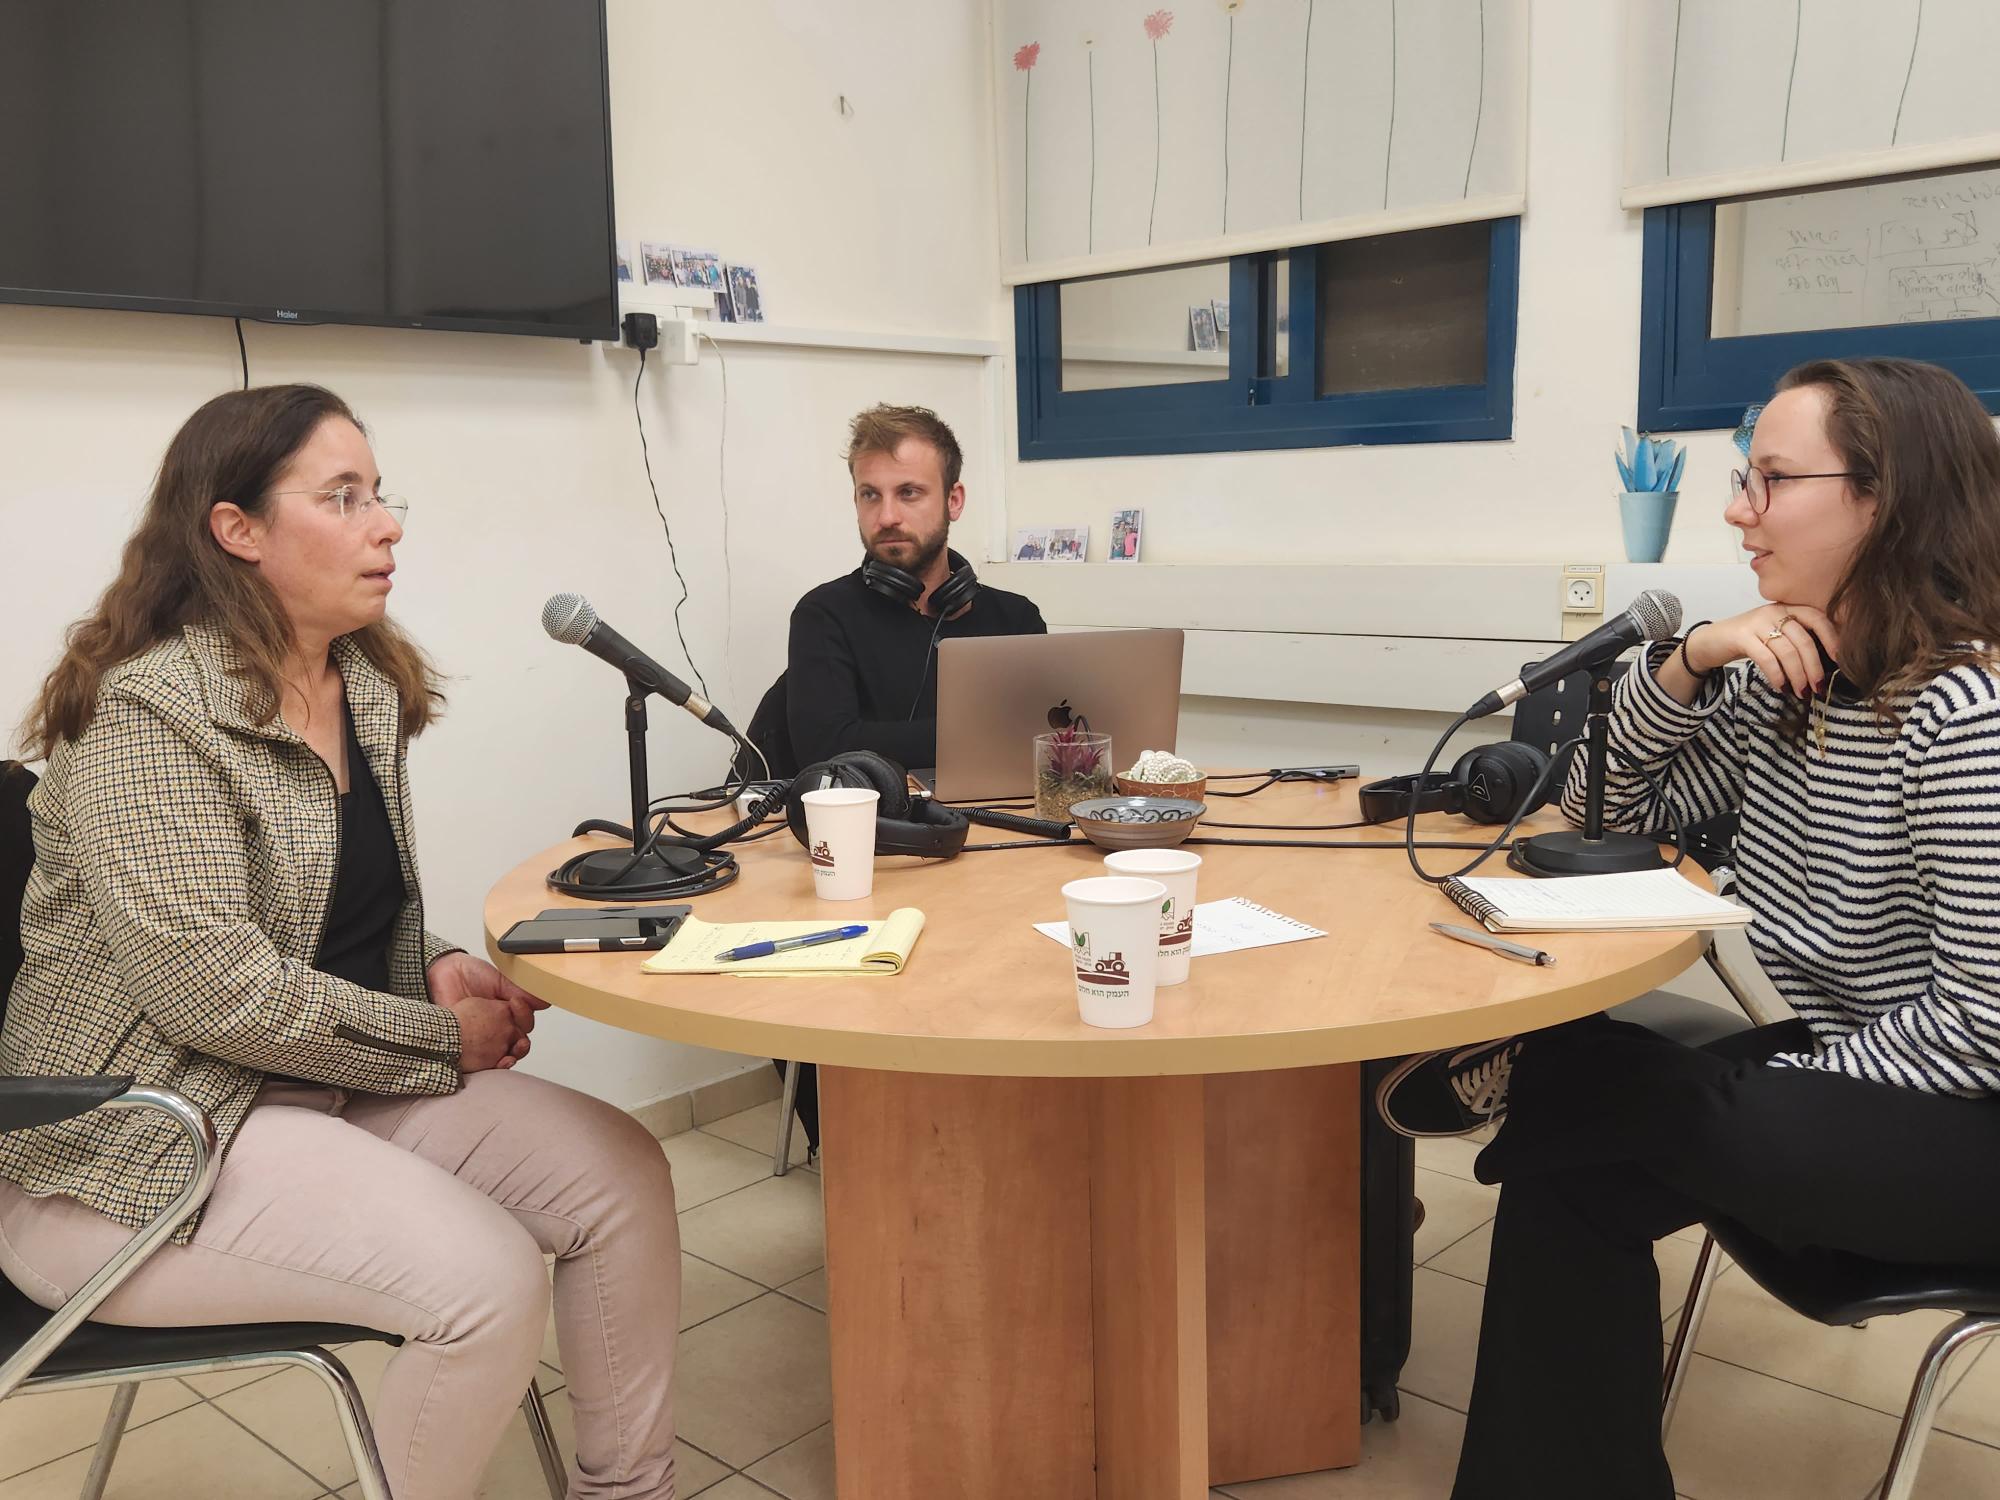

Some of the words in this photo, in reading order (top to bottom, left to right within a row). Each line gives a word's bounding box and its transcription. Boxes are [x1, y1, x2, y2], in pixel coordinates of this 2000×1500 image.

[276, 309, 298, 319] Haier
[1091, 988, 1105, 997] הוא
[1106, 990, 1129, 999] העמק
